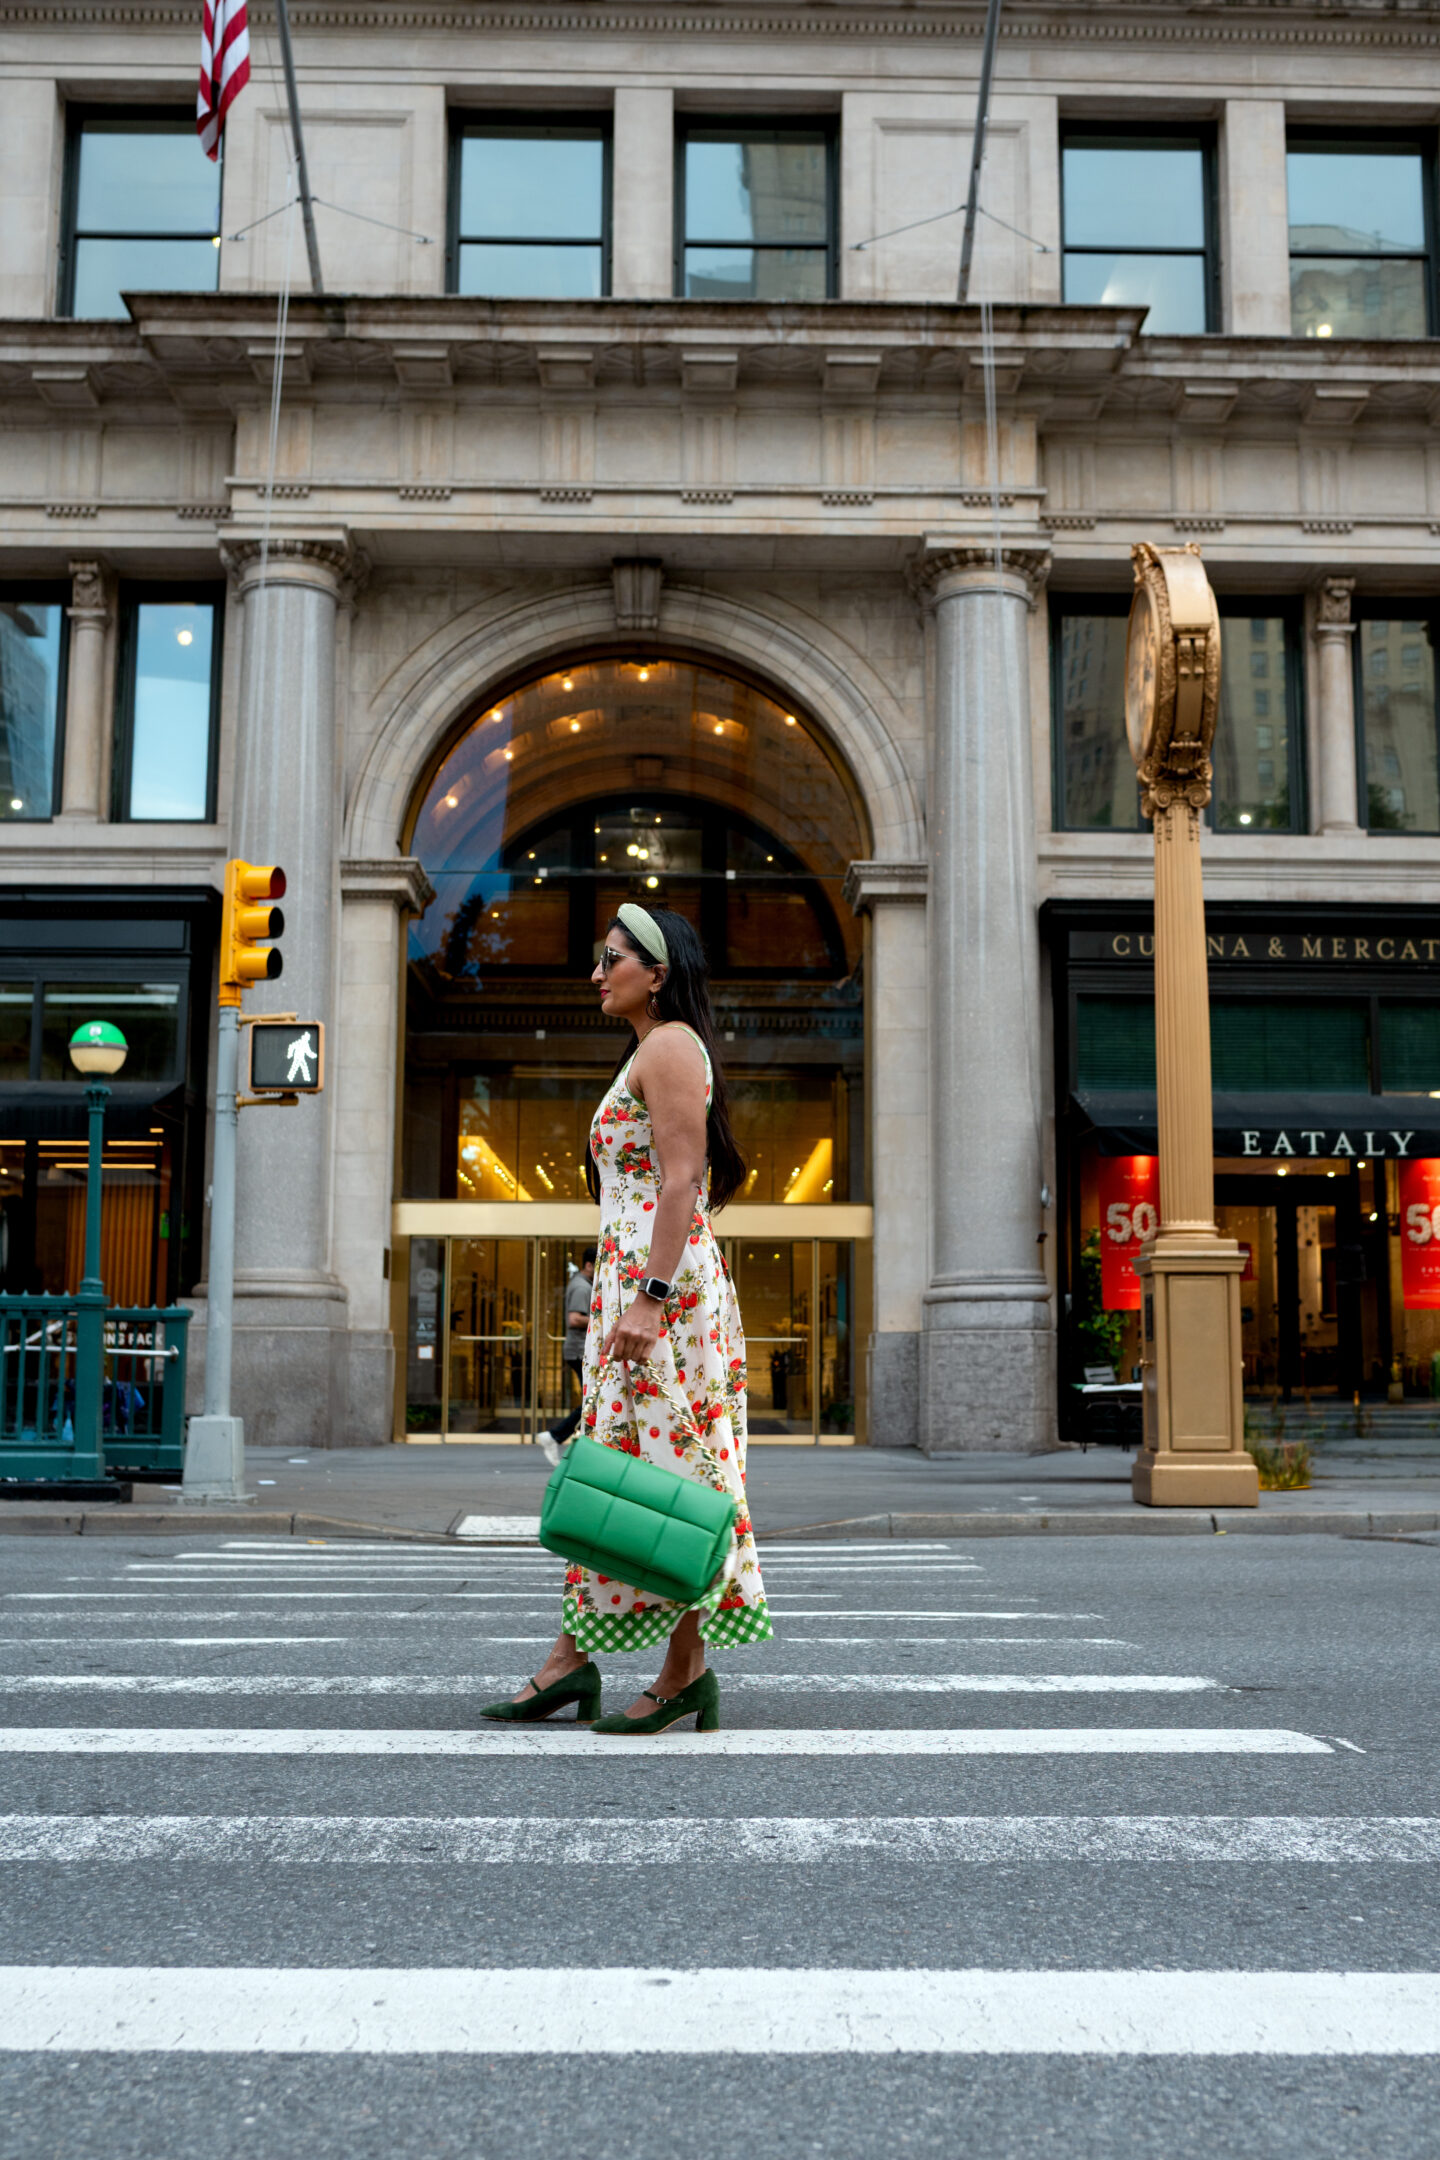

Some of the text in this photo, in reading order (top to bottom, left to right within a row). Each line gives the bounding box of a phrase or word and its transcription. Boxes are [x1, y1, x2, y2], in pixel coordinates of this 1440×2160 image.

[1112, 935, 1250, 957] CUNA
[1267, 936, 1286, 958] &
[1241, 1130, 1415, 1156] EATALY
[1107, 1202, 1158, 1243] 50
